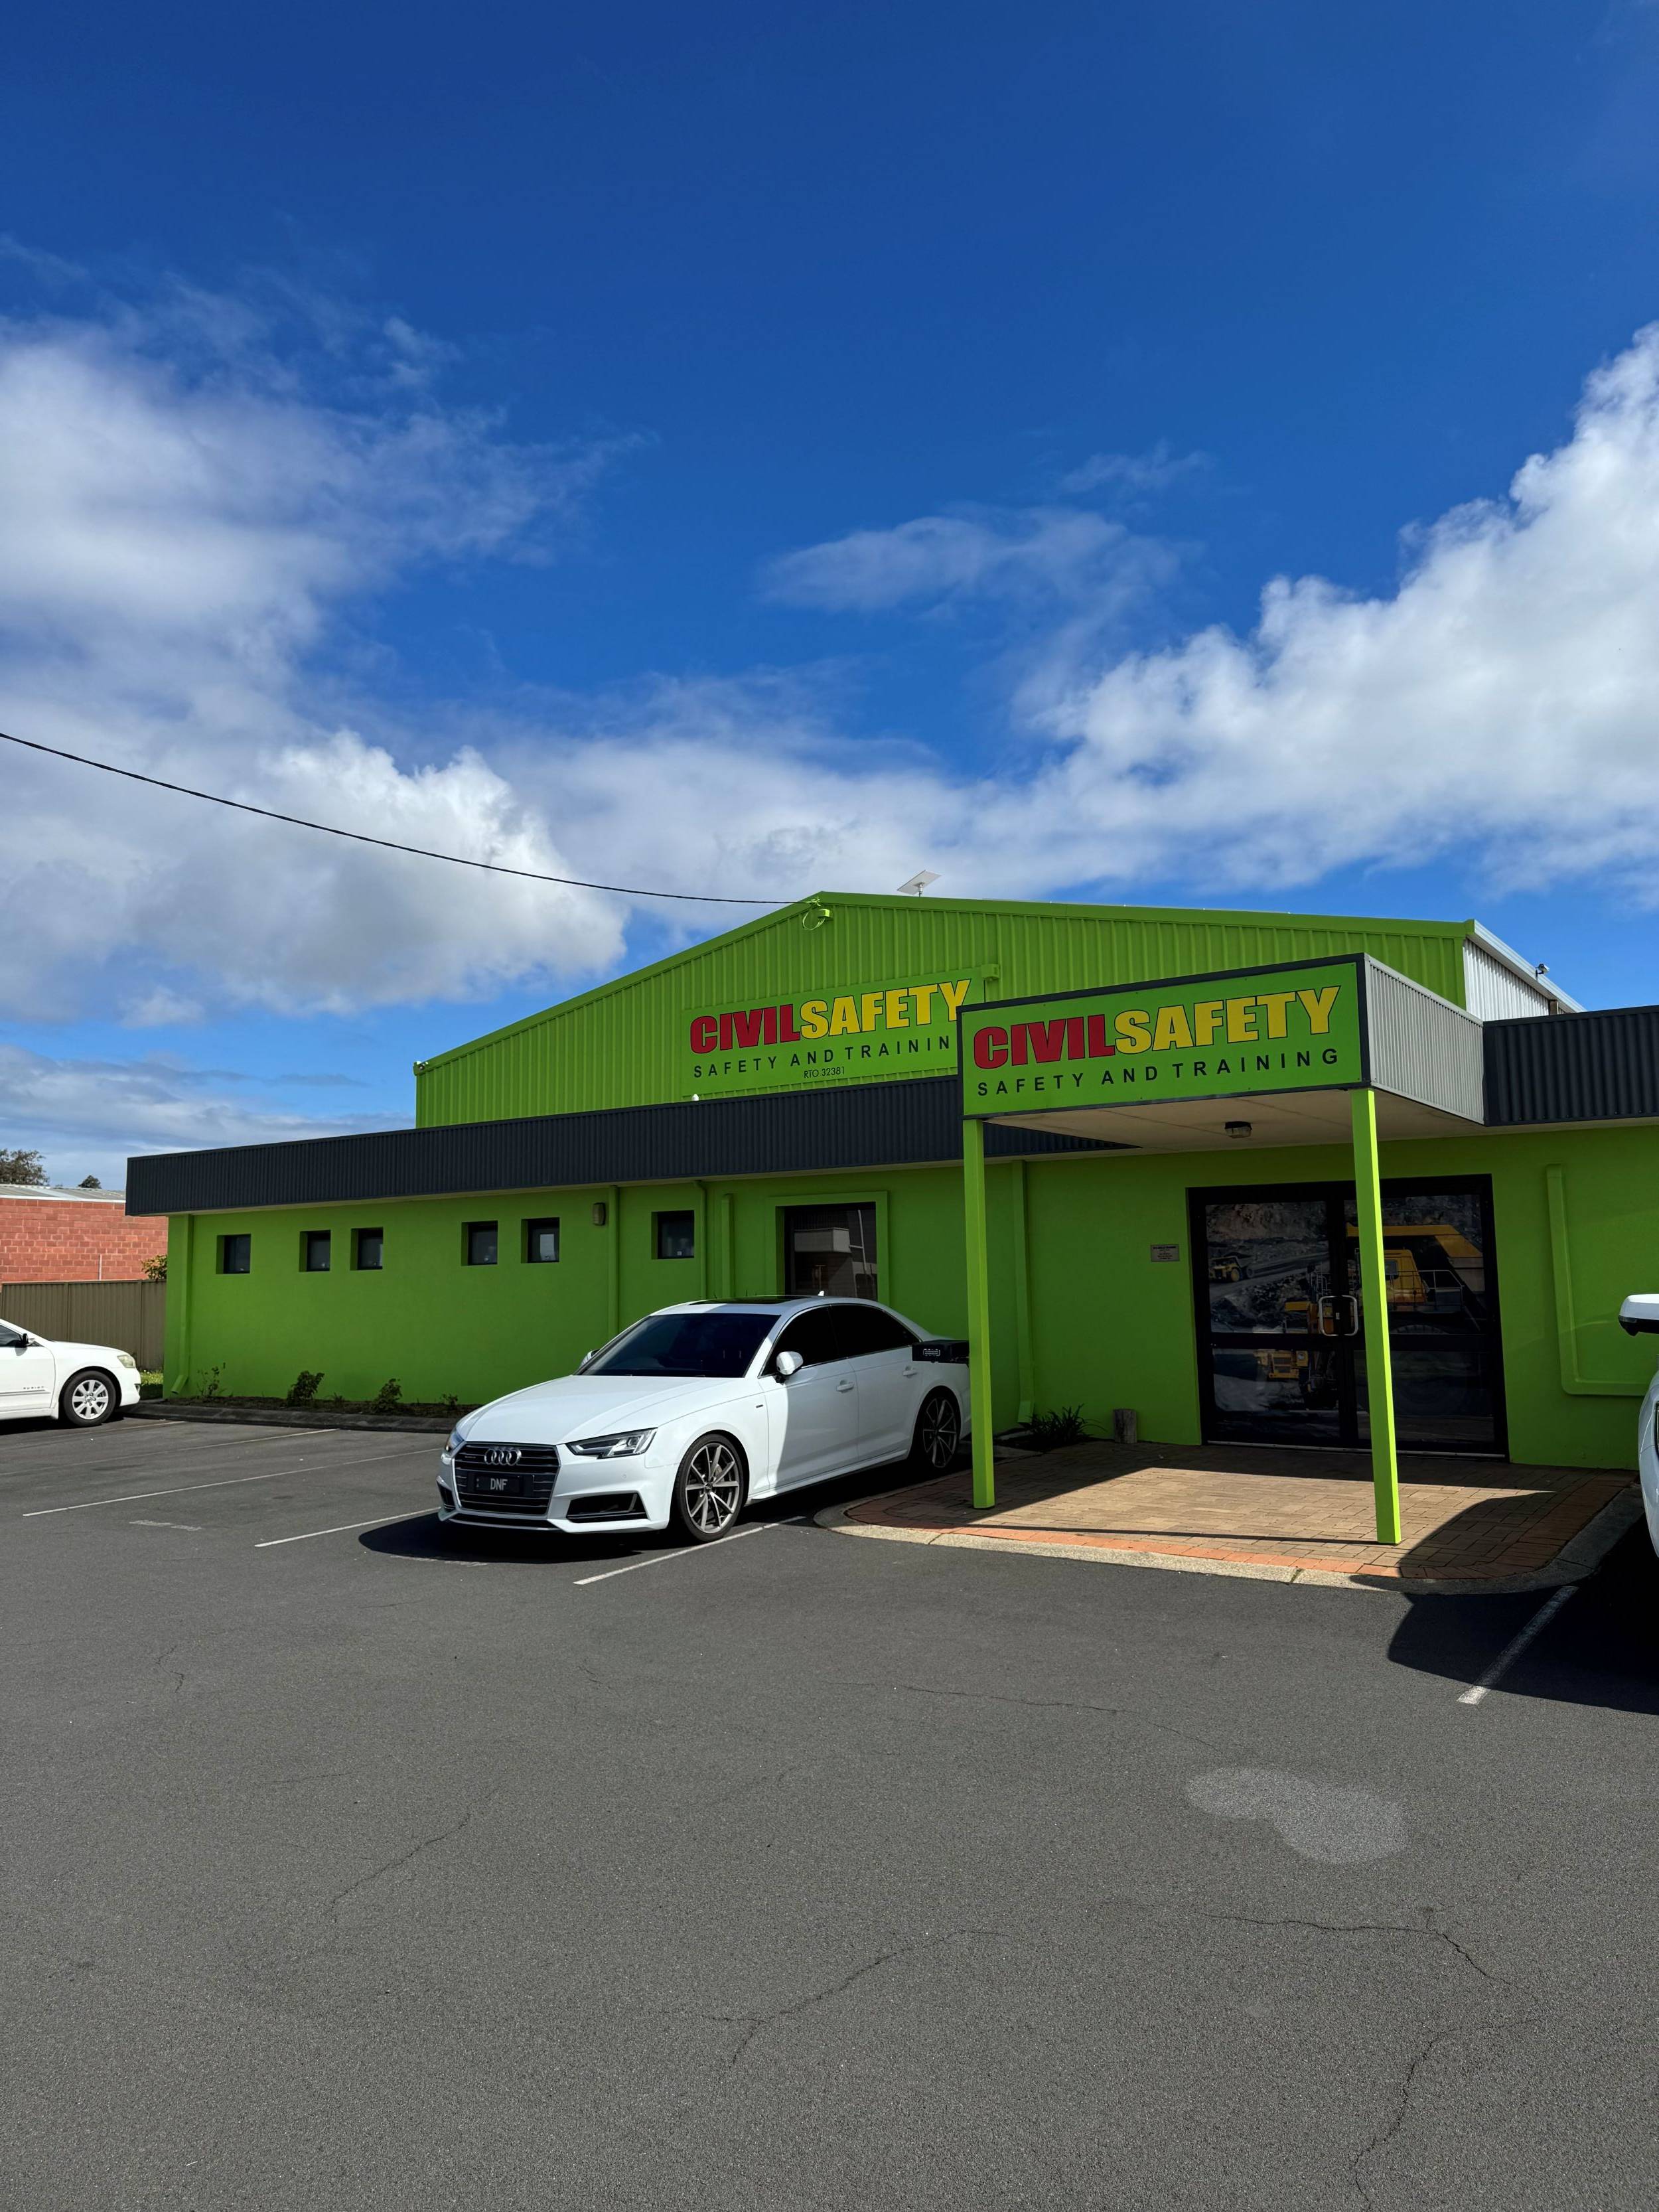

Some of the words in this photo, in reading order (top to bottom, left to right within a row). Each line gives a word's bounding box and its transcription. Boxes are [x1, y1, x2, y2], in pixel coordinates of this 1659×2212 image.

[694, 1056, 777, 1078] SAFETY
[790, 1049, 833, 1067] AND
[845, 1035, 950, 1060] TRAININ
[804, 1069, 819, 1078] RTO
[822, 1066, 845, 1076] 32381
[978, 1074, 1084, 1096] SAFETY
[1102, 1066, 1158, 1085] AND
[1173, 1049, 1338, 1078] TRAINING
[490, 1478, 508, 1491] DNF
